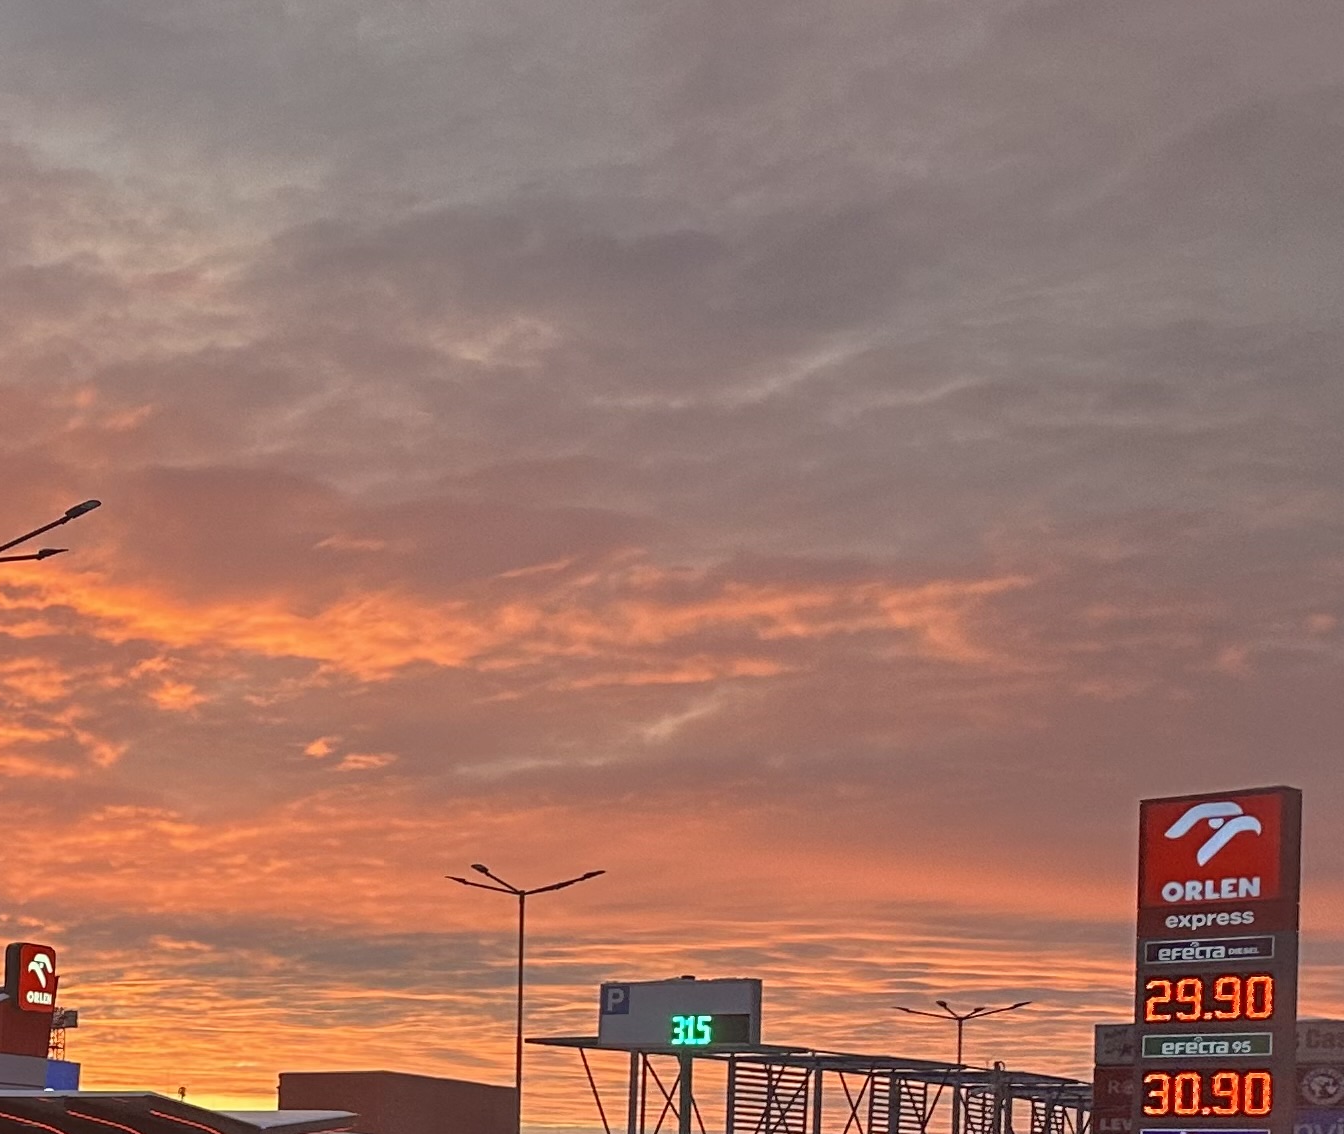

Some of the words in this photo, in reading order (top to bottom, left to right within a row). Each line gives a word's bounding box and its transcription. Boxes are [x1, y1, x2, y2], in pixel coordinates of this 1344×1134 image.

[1162, 876, 1261, 902] ORLEN
[1165, 911, 1255, 930] express
[1228, 946, 1260, 955] DIESEL
[26, 990, 53, 1005] ORLEN
[1146, 975, 1273, 1021] 29.90
[672, 1015, 712, 1045] 315
[1231, 1040, 1252, 1053] 95
[1143, 1072, 1272, 1115] 30.90
